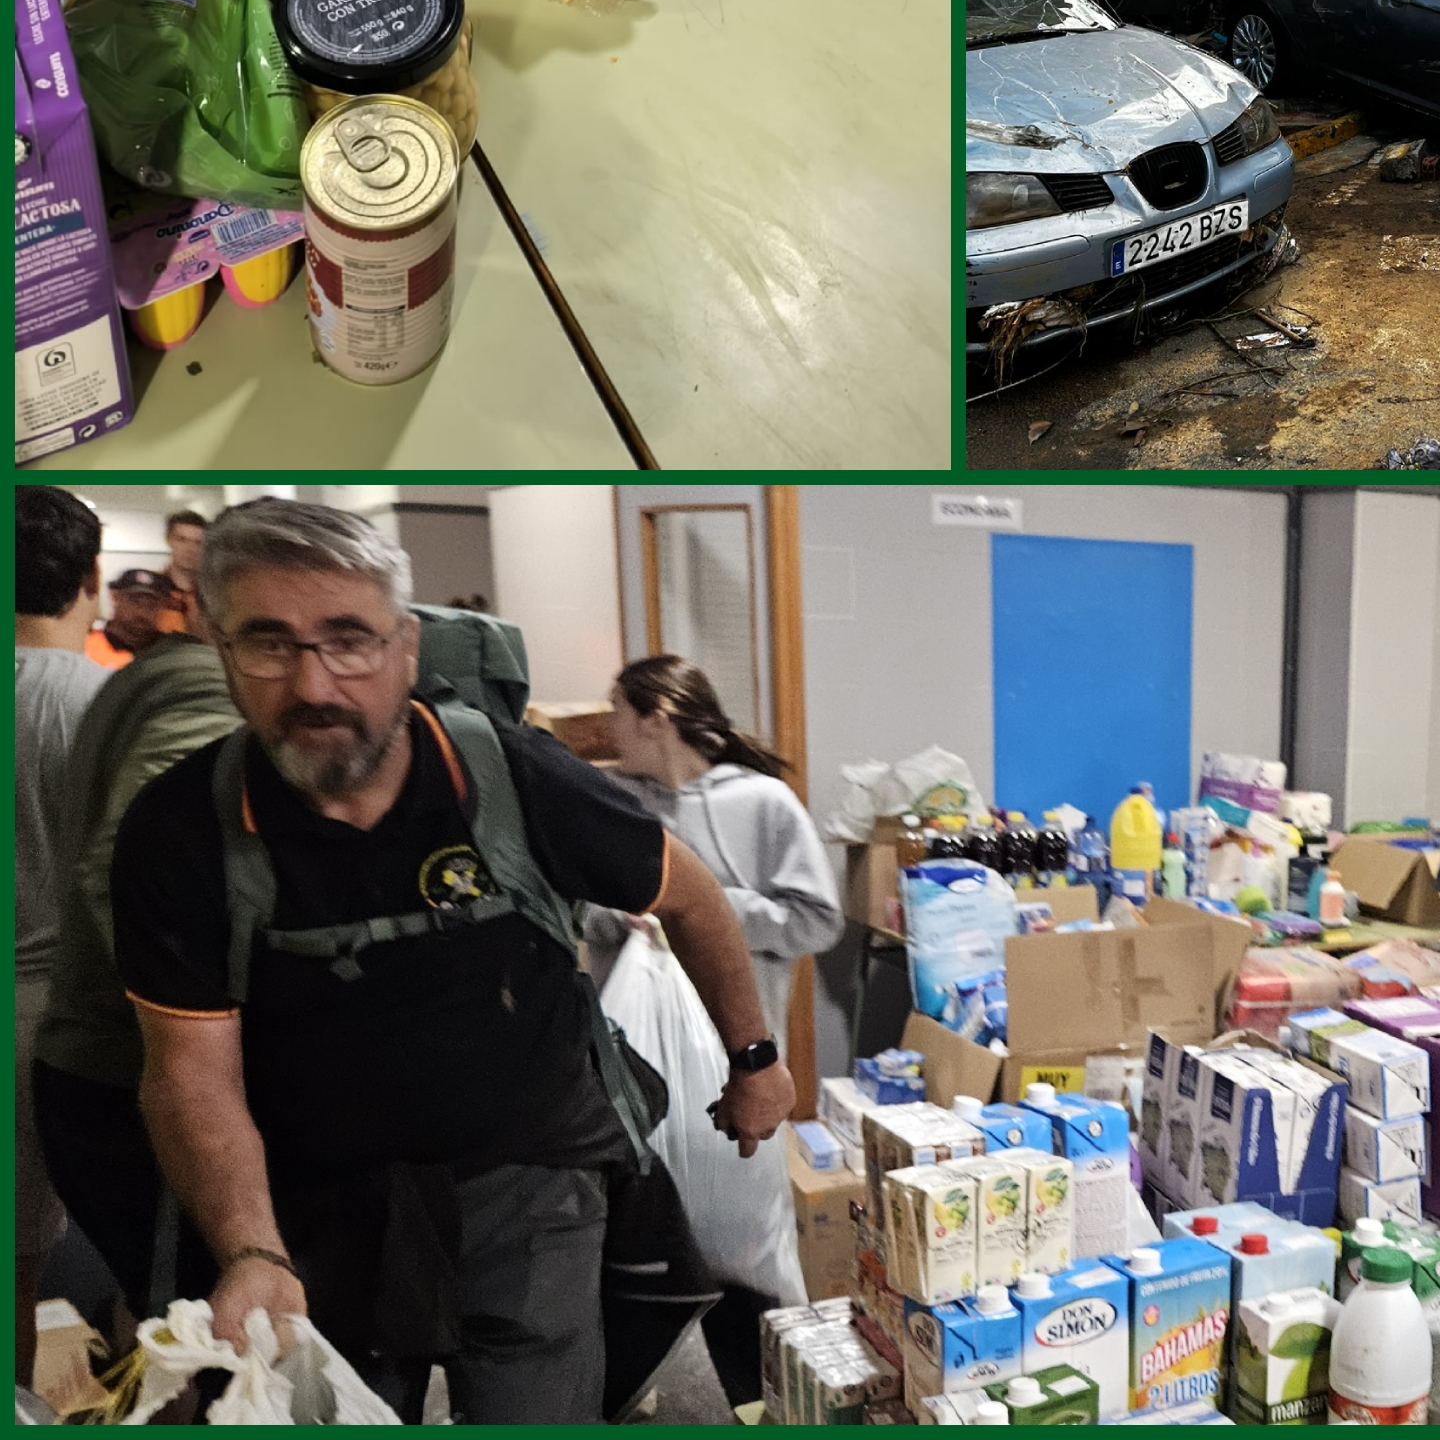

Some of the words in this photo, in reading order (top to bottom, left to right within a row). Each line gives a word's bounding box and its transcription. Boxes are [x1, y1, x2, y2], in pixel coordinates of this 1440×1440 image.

[326, 5, 357, 22] CON
[361, 20, 378, 33] 550
[48, 51, 70, 98] consum
[156, 202, 235, 239] Danonino
[1128, 221, 1193, 268] 2242
[1200, 205, 1244, 243] BZS
[1037, 1070, 1070, 1089] MUY
[1047, 1313, 1109, 1342] SIMON
[1061, 1302, 1094, 1322] DON
[1140, 1308, 1229, 1384] BAHAMAS
[1163, 1368, 1221, 1404] LITROS
